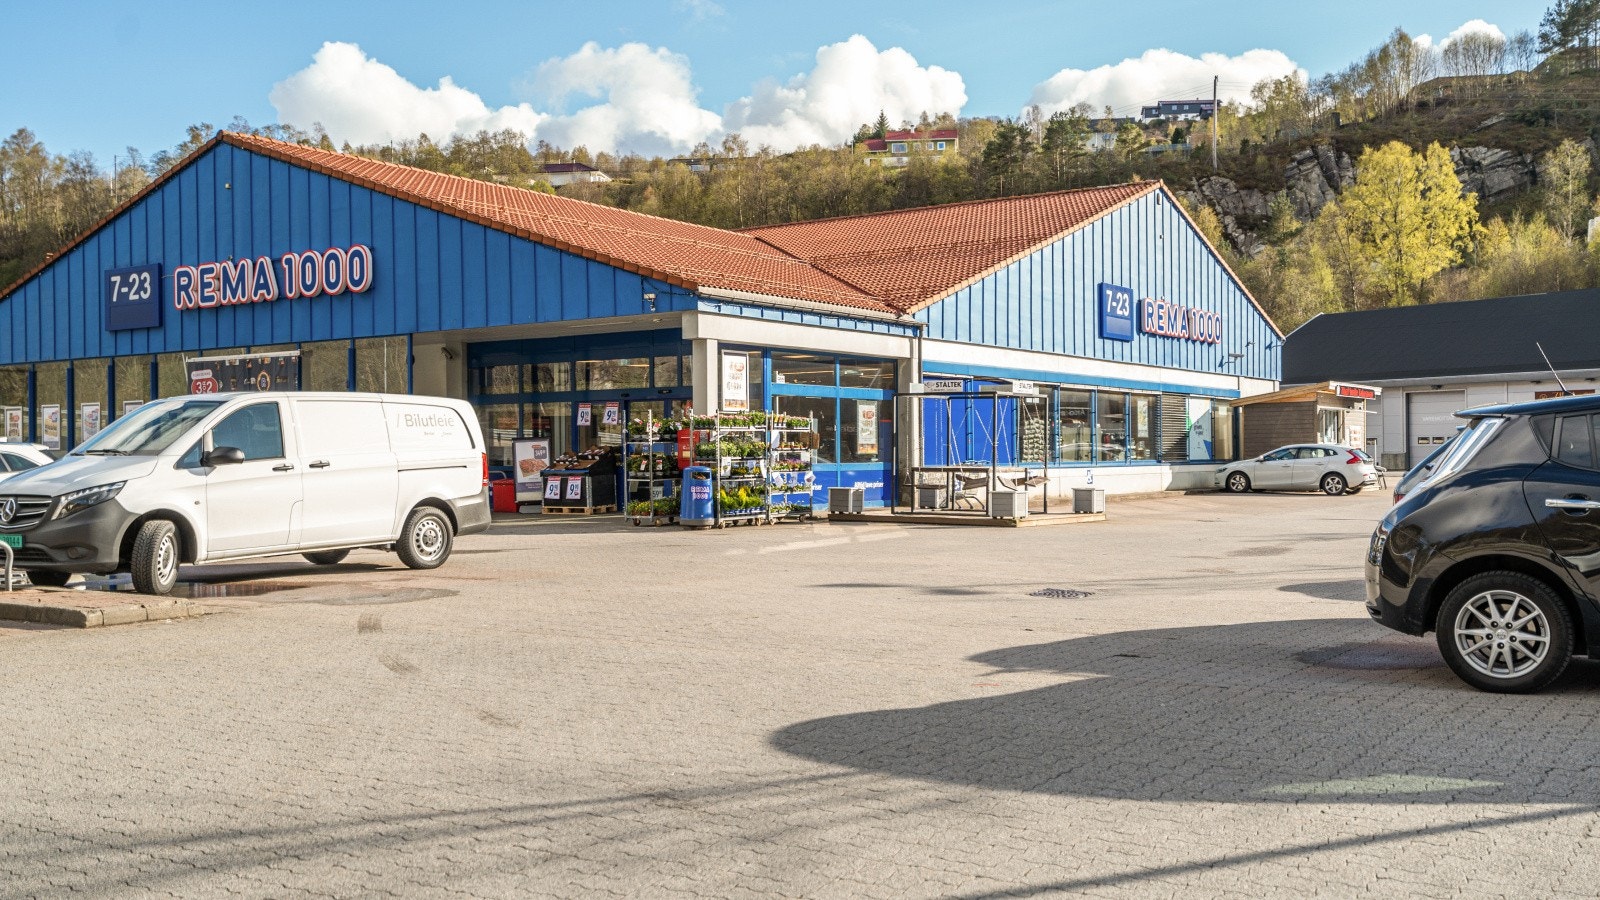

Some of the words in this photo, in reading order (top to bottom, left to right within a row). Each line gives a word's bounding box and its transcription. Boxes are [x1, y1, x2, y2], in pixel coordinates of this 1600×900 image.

[110, 271, 151, 302] 7-23
[174, 255, 278, 310] REMA
[281, 244, 372, 299] 1000
[1105, 289, 1130, 317] 7-23
[1143, 297, 1190, 339] REMA
[1190, 307, 1221, 344] 1000
[404, 413, 455, 427] Bilutleie
